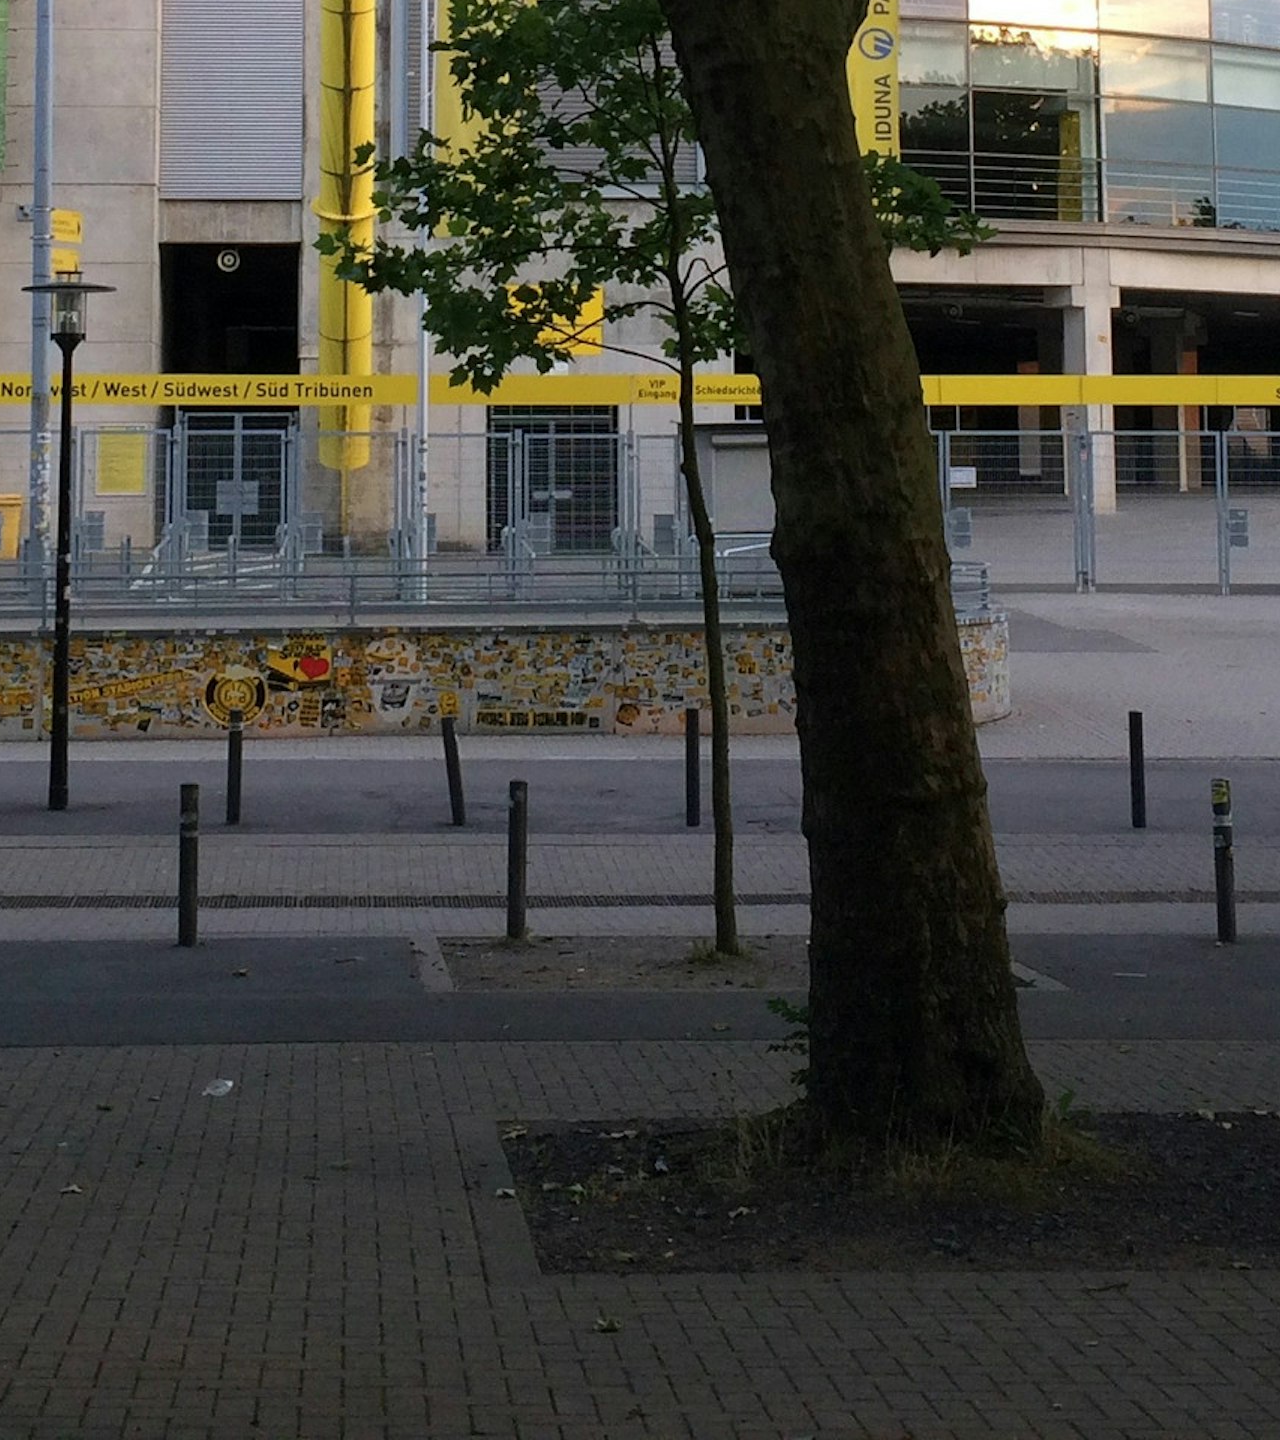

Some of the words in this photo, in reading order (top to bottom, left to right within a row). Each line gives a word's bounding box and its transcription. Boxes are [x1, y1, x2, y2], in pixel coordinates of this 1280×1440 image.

[874, 73, 892, 141] IDUNA
[104, 382, 147, 398] West
[163, 381, 238, 398] Südwest
[256, 381, 289, 398] Süd
[294, 381, 373, 398] Tribünen
[649, 379, 666, 389] VIP
[638, 389, 677, 400] Eingang
